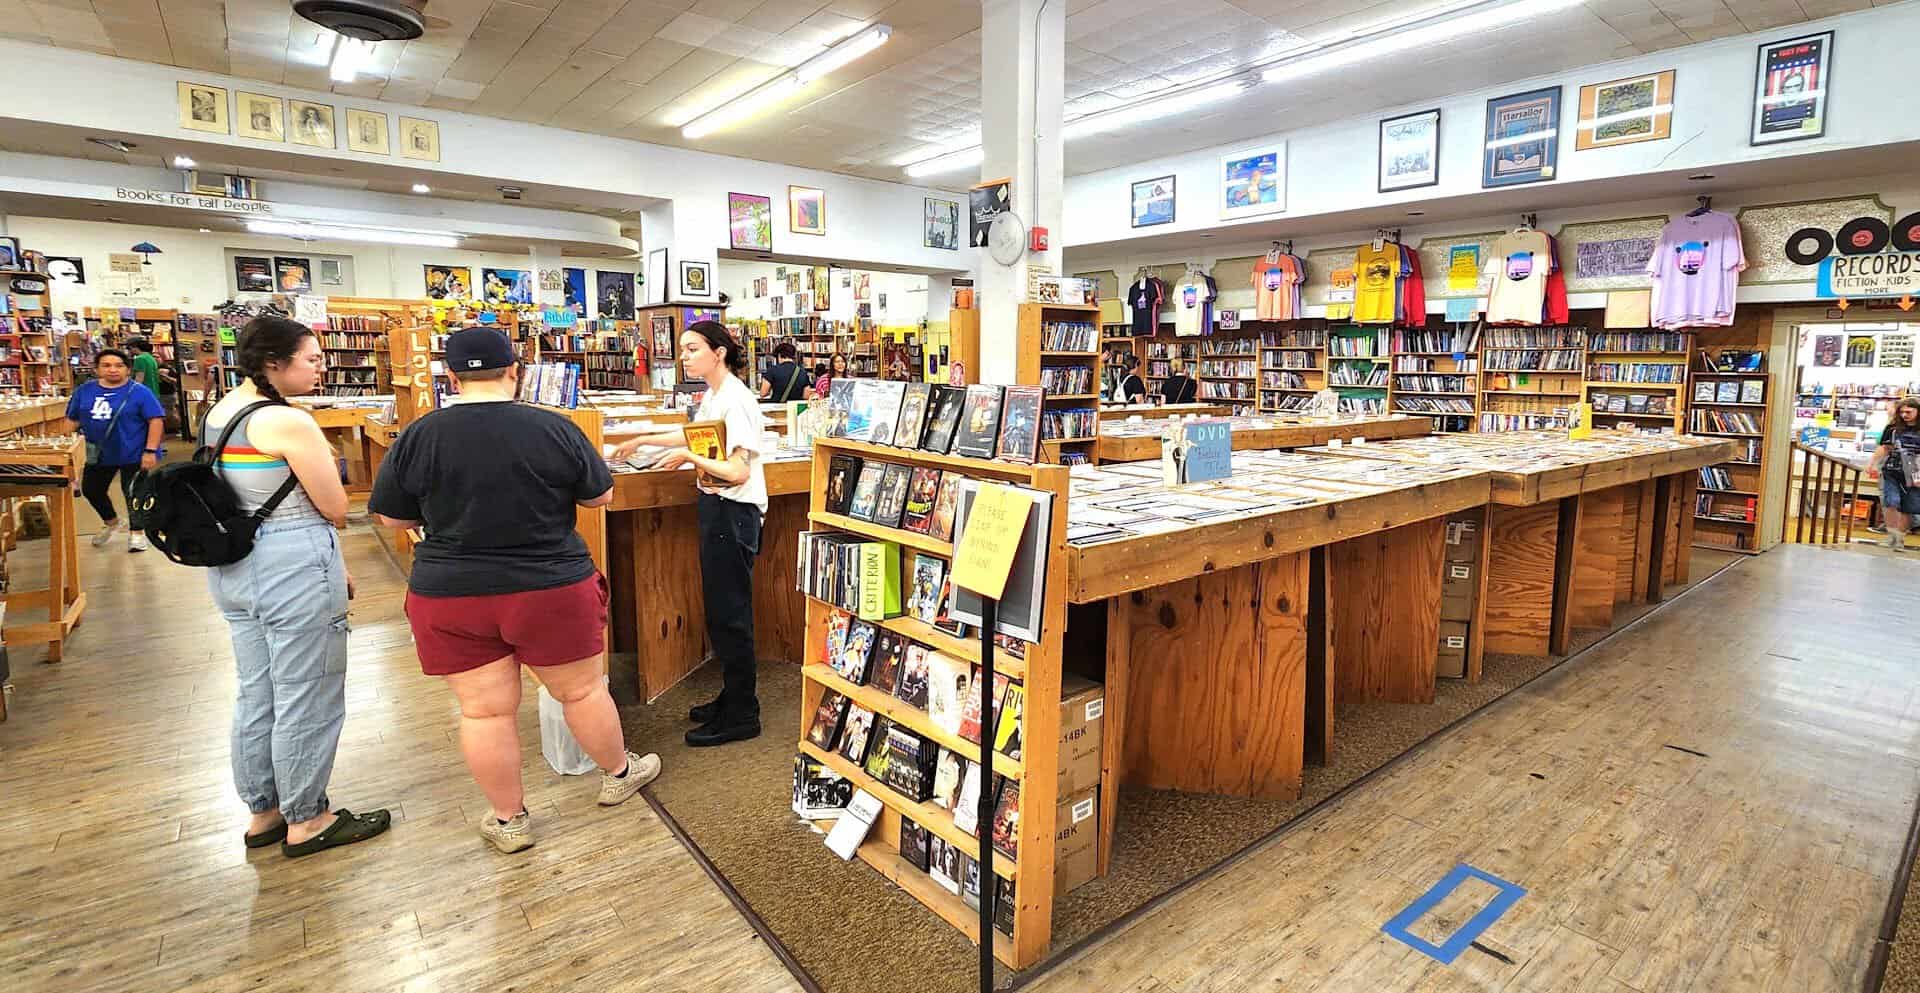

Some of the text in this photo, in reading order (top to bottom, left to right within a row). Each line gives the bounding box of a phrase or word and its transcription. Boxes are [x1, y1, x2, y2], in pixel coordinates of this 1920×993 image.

[116, 187, 164, 202] Books
[170, 193, 193, 206] for
[199, 199, 218, 209] tall
[1836, 275, 1911, 288] FICTION KIDS
[411, 332, 432, 408] LOCA
[90, 397, 112, 419] LA
[1198, 426, 1226, 440] DVD
[865, 553, 879, 613] CRITERION
